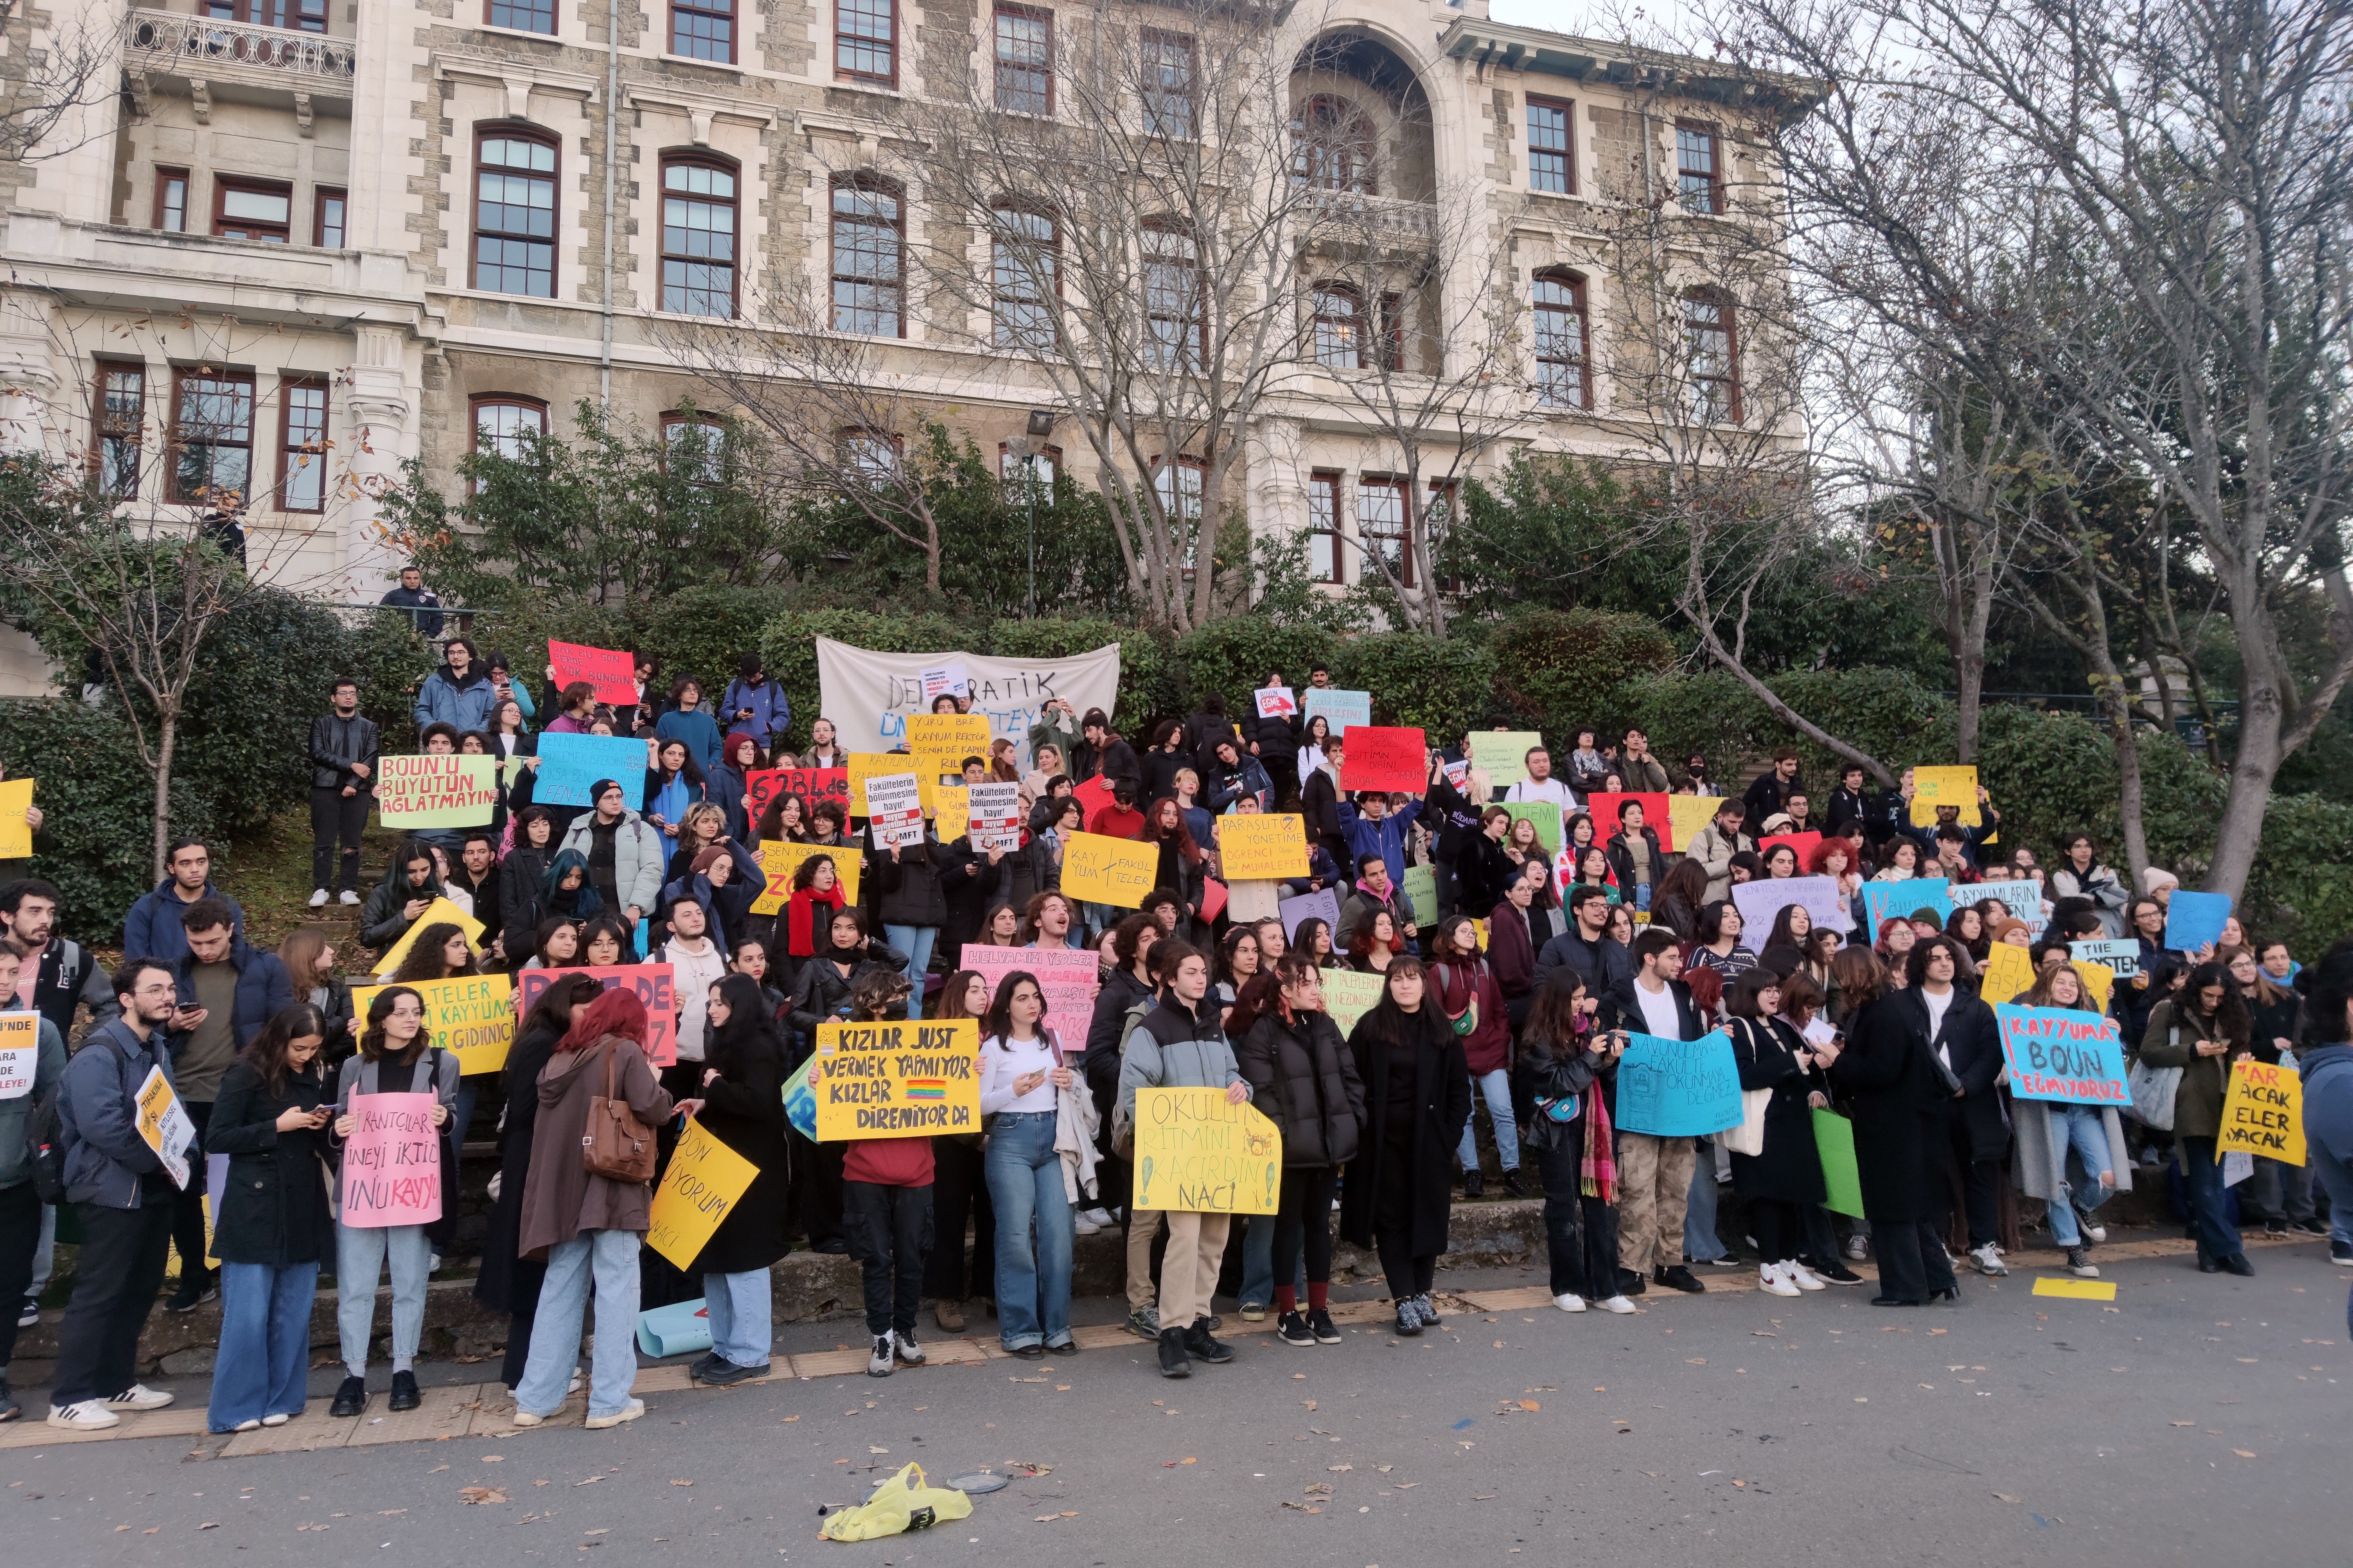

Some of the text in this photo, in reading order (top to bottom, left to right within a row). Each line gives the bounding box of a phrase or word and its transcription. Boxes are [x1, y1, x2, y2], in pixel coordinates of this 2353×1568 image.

[552, 643, 620, 664] BAK BU SON
[561, 666, 630, 685] YOK BUNDAN
[1262, 697, 1281, 709] EĞME
[1311, 692, 1331, 701] TÜM
[914, 716, 975, 727] YÜRÜ BRE
[914, 732, 988, 743] KAYYUM REKTÖR
[1348, 730, 1405, 741] MAĞARANIN
[541, 735, 643, 754] SEN Mİ GERÇEK İSMİNİ
[917, 745, 985, 755] SENİN DE KAPIN
[540, 748, 587, 764] SÖYLEMEK
[869, 754, 926, 768] KAYYUMUN
[537, 766, 566, 781] YOKSA
[573, 769, 590, 783] BEN
[1343, 772, 1377, 788] BÜMAK
[1384, 768, 1426, 780] GÖRDÜK
[383, 773, 474, 798] BÜYÜTÜN
[869, 778, 914, 793] Fakültelerin
[972, 786, 1015, 797] Fakültelerin
[868, 788, 918, 803] bölünmesine
[939, 789, 957, 798] BEN
[382, 790, 494, 813] AĞLATMAYIN
[883, 800, 905, 811] hayır!
[970, 798, 1018, 807] bölünmesine
[883, 812, 908, 822] Kayyum
[939, 811, 949, 820] NE
[984, 808, 1005, 818] hayır!
[1451, 811, 1478, 826] BÜDANS
[873, 816, 921, 832] keyfiyetine son!
[971, 825, 1018, 836] keyfiyetine son!
[982, 819, 1006, 828] Kayyum
[1222, 817, 1279, 833] PARAŞÜT
[899, 831, 917, 841] MFT
[1246, 832, 1303, 845] YÖNETİME
[767, 845, 790, 856] SEN
[1071, 849, 1098, 866] KAY
[1225, 846, 1272, 861] ÖĞRENCİ
[766, 860, 788, 872] SEN
[1071, 862, 1098, 879] YUM
[1118, 857, 1152, 872] FAKÜL
[1241, 855, 1307, 873] MUHALEFETİ
[1115, 872, 1150, 886] TELER
[1738, 883, 1776, 896] SENATO
[760, 899, 774, 910] DA
[1762, 895, 1782, 909] GERİ
[968, 951, 1093, 967] HELVAMIZI YEDİLER
[1039, 987, 1085, 1000] KARŞI
[440, 999, 513, 1025] KAYYUM
[2010, 1015, 2115, 1042] KAYYUMA
[839, 1027, 959, 1052] KIZLAR JUST
[2028, 1040, 2103, 1078] BOUN
[822, 1053, 972, 1081] VERMEK YAPMIYOR
[830, 1079, 892, 1105] KIZLAR
[2022, 1072, 2127, 1102] EĞMİYORUZ
[857, 1104, 969, 1130] DİRENİYOR DA
[1152, 1094, 1259, 1125] OKULUN
[362, 1111, 433, 1134] RANTÇILAR
[1143, 1124, 1232, 1153] RİTMİNİ
[650, 1219, 680, 1248] NACİ
